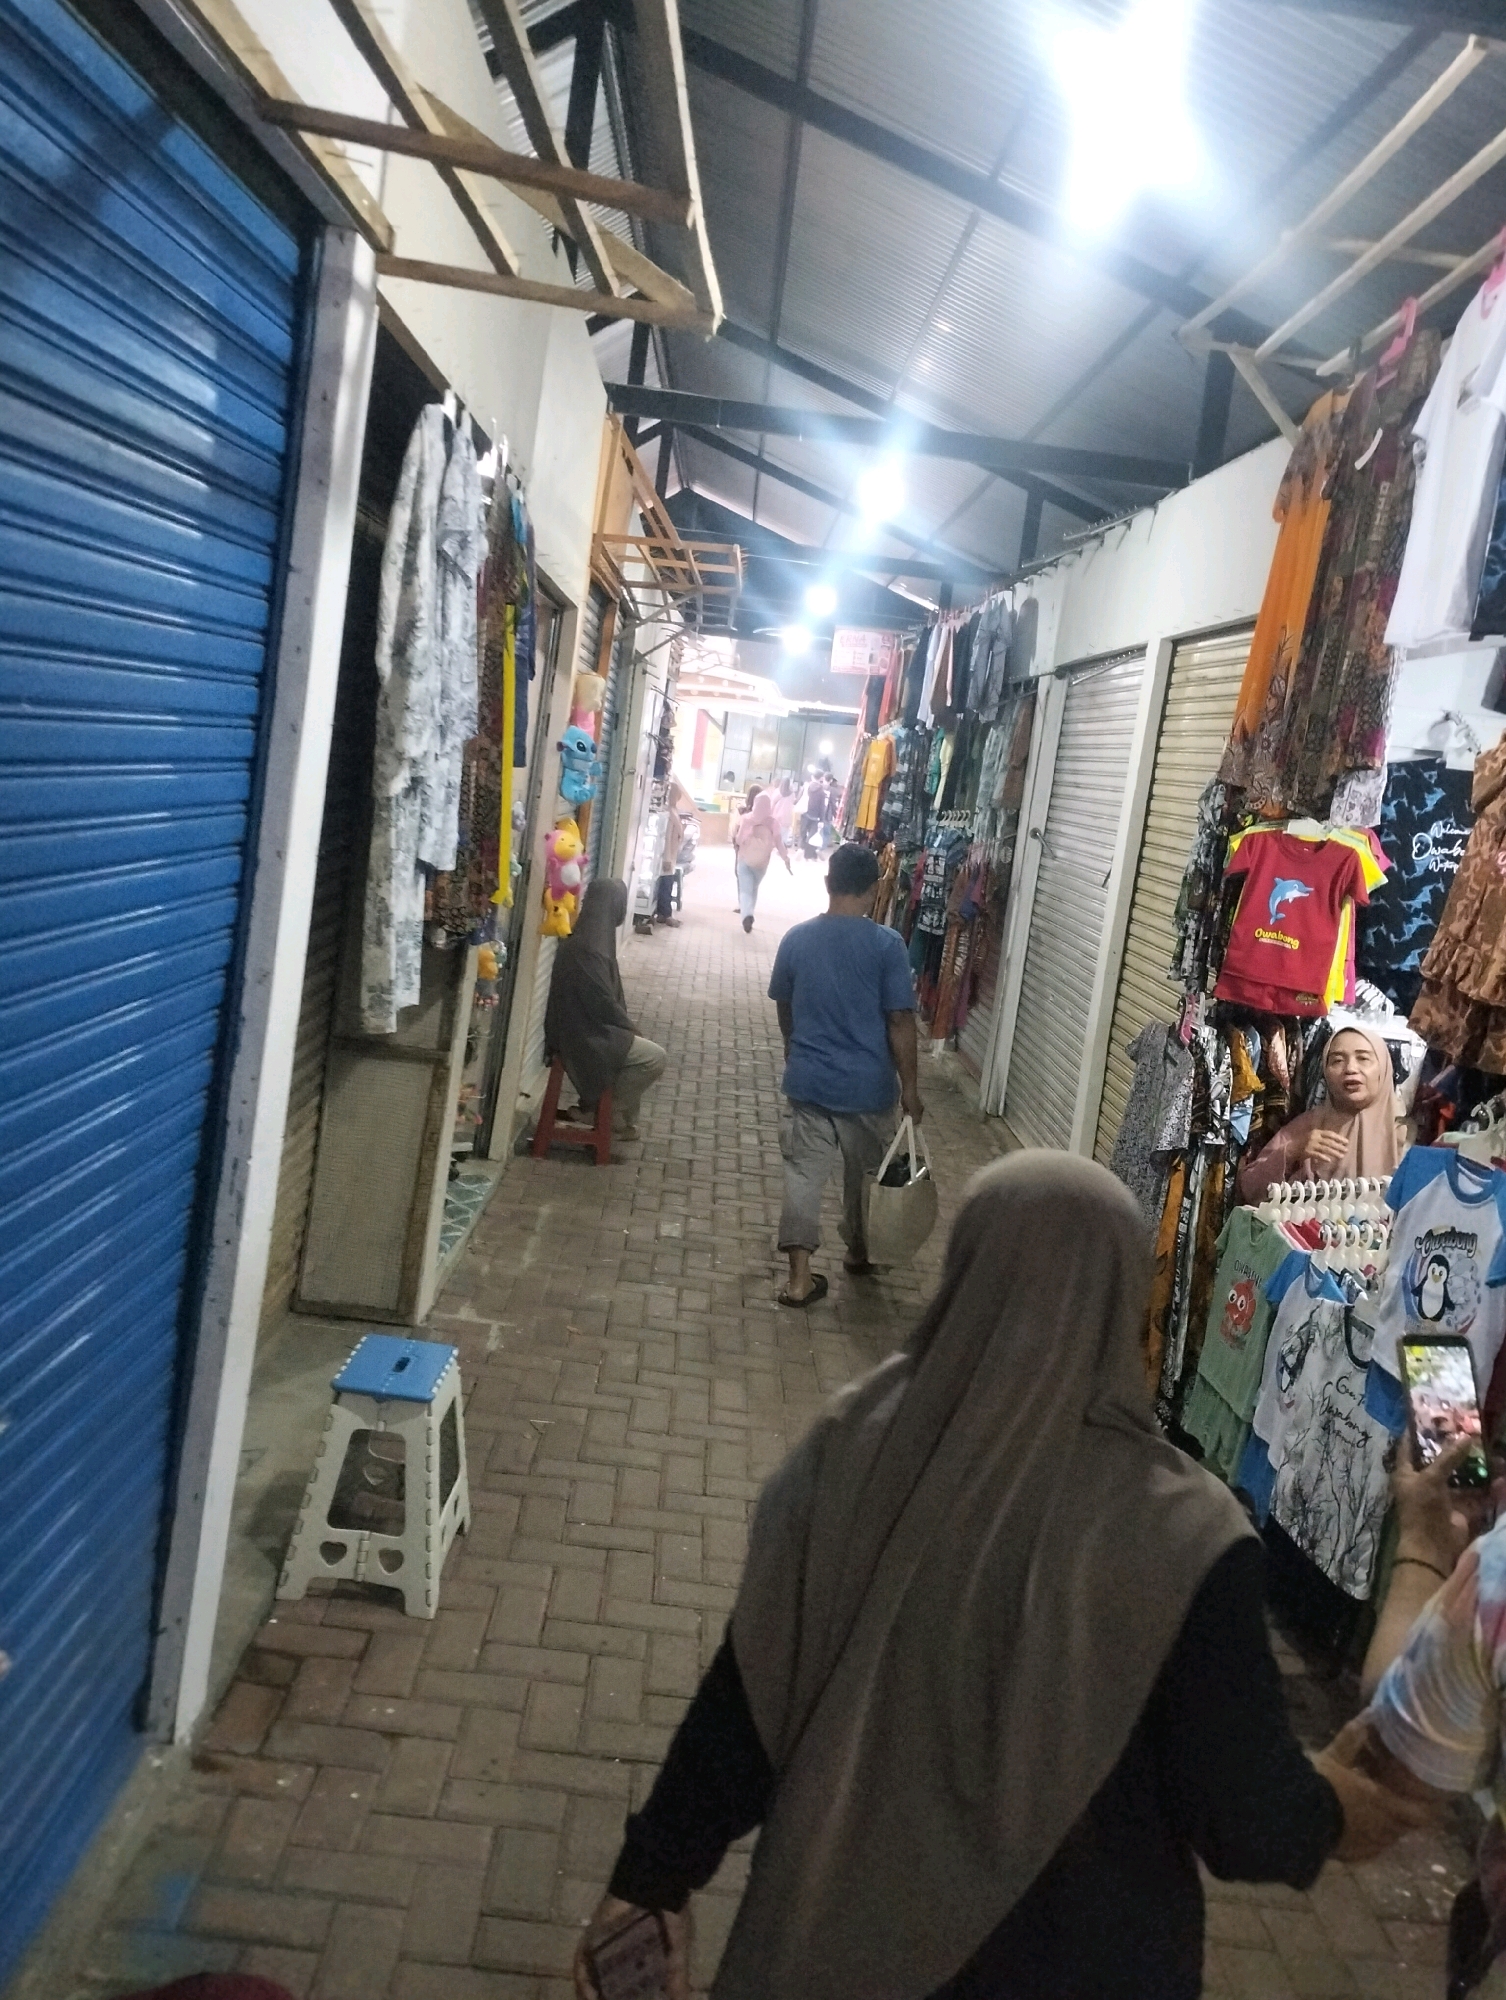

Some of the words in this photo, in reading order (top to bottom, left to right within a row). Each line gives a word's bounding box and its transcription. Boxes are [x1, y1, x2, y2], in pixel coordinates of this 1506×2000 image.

[1412, 833, 1465, 860] Owabo
[1255, 928, 1300, 950] Owabong
[1415, 1226, 1478, 1258] Owabong
